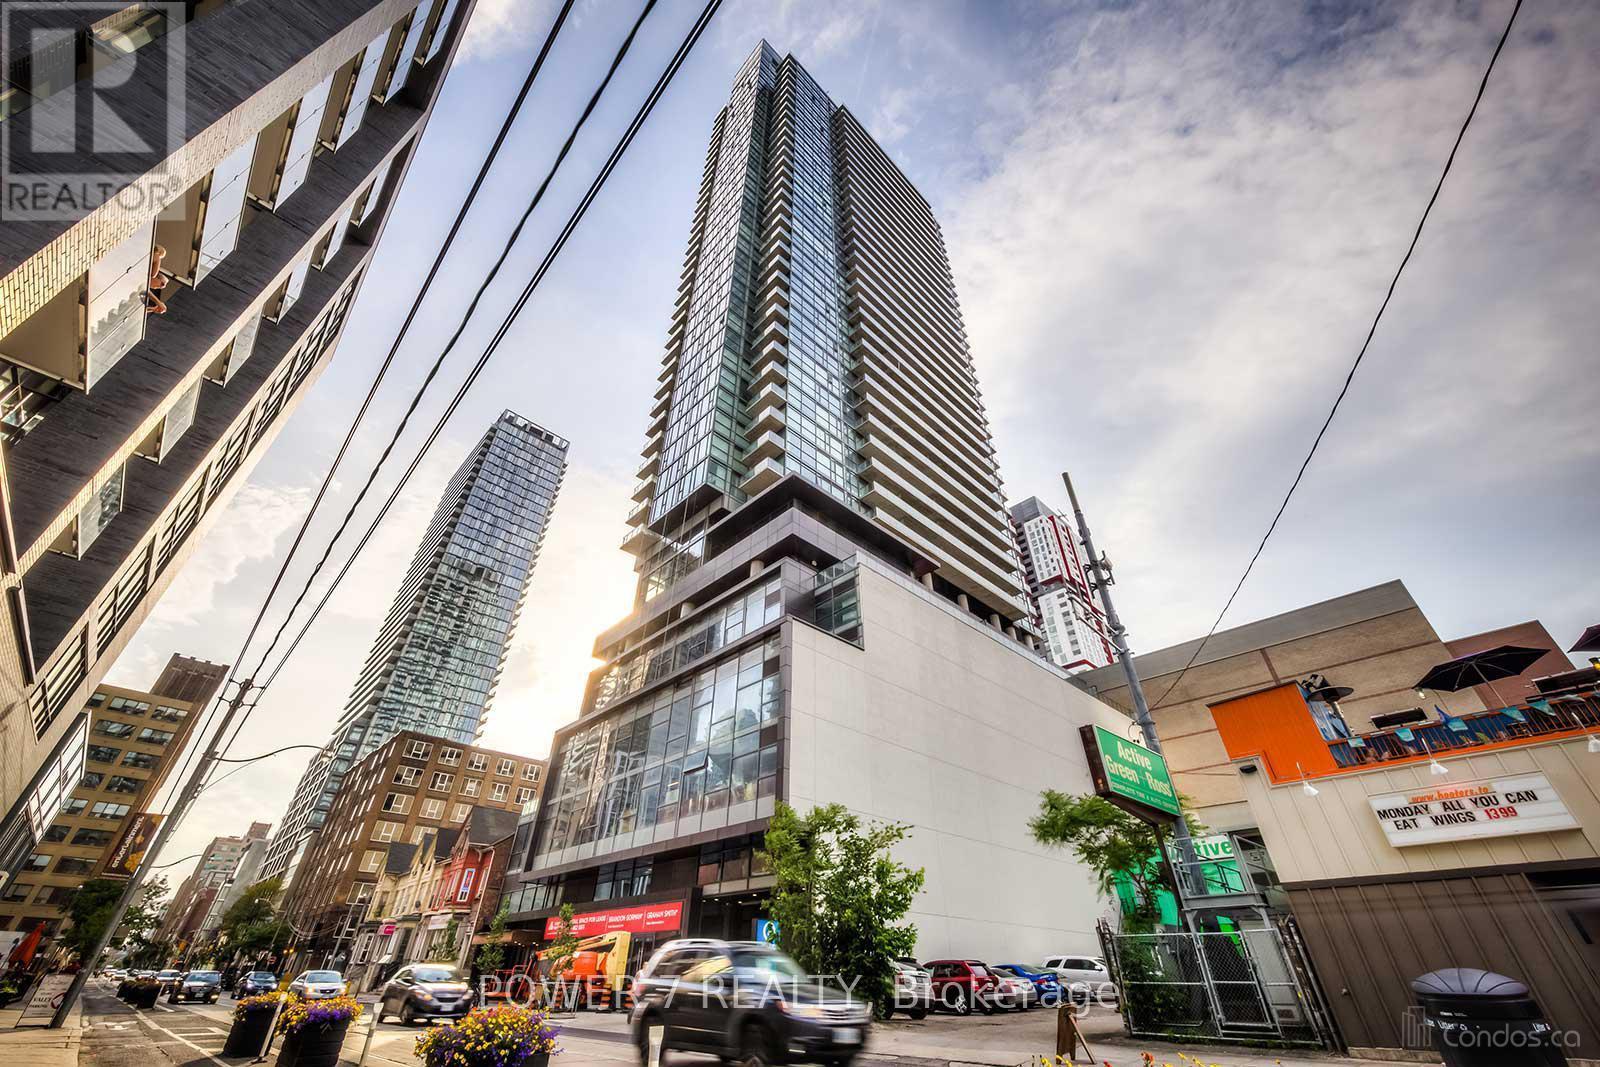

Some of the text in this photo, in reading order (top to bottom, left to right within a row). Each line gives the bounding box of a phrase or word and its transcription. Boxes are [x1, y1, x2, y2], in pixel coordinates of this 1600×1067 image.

[1117, 742, 1152, 771] Active
[1104, 754, 1173, 798] Green Ross
[1376, 790, 1538, 820] MONDAY ALL YOU CAN
[1411, 786, 1489, 803] www.hooters.to
[1394, 805, 1518, 831] EAT WINGS 1399
[111, 815, 145, 868] entertainment
